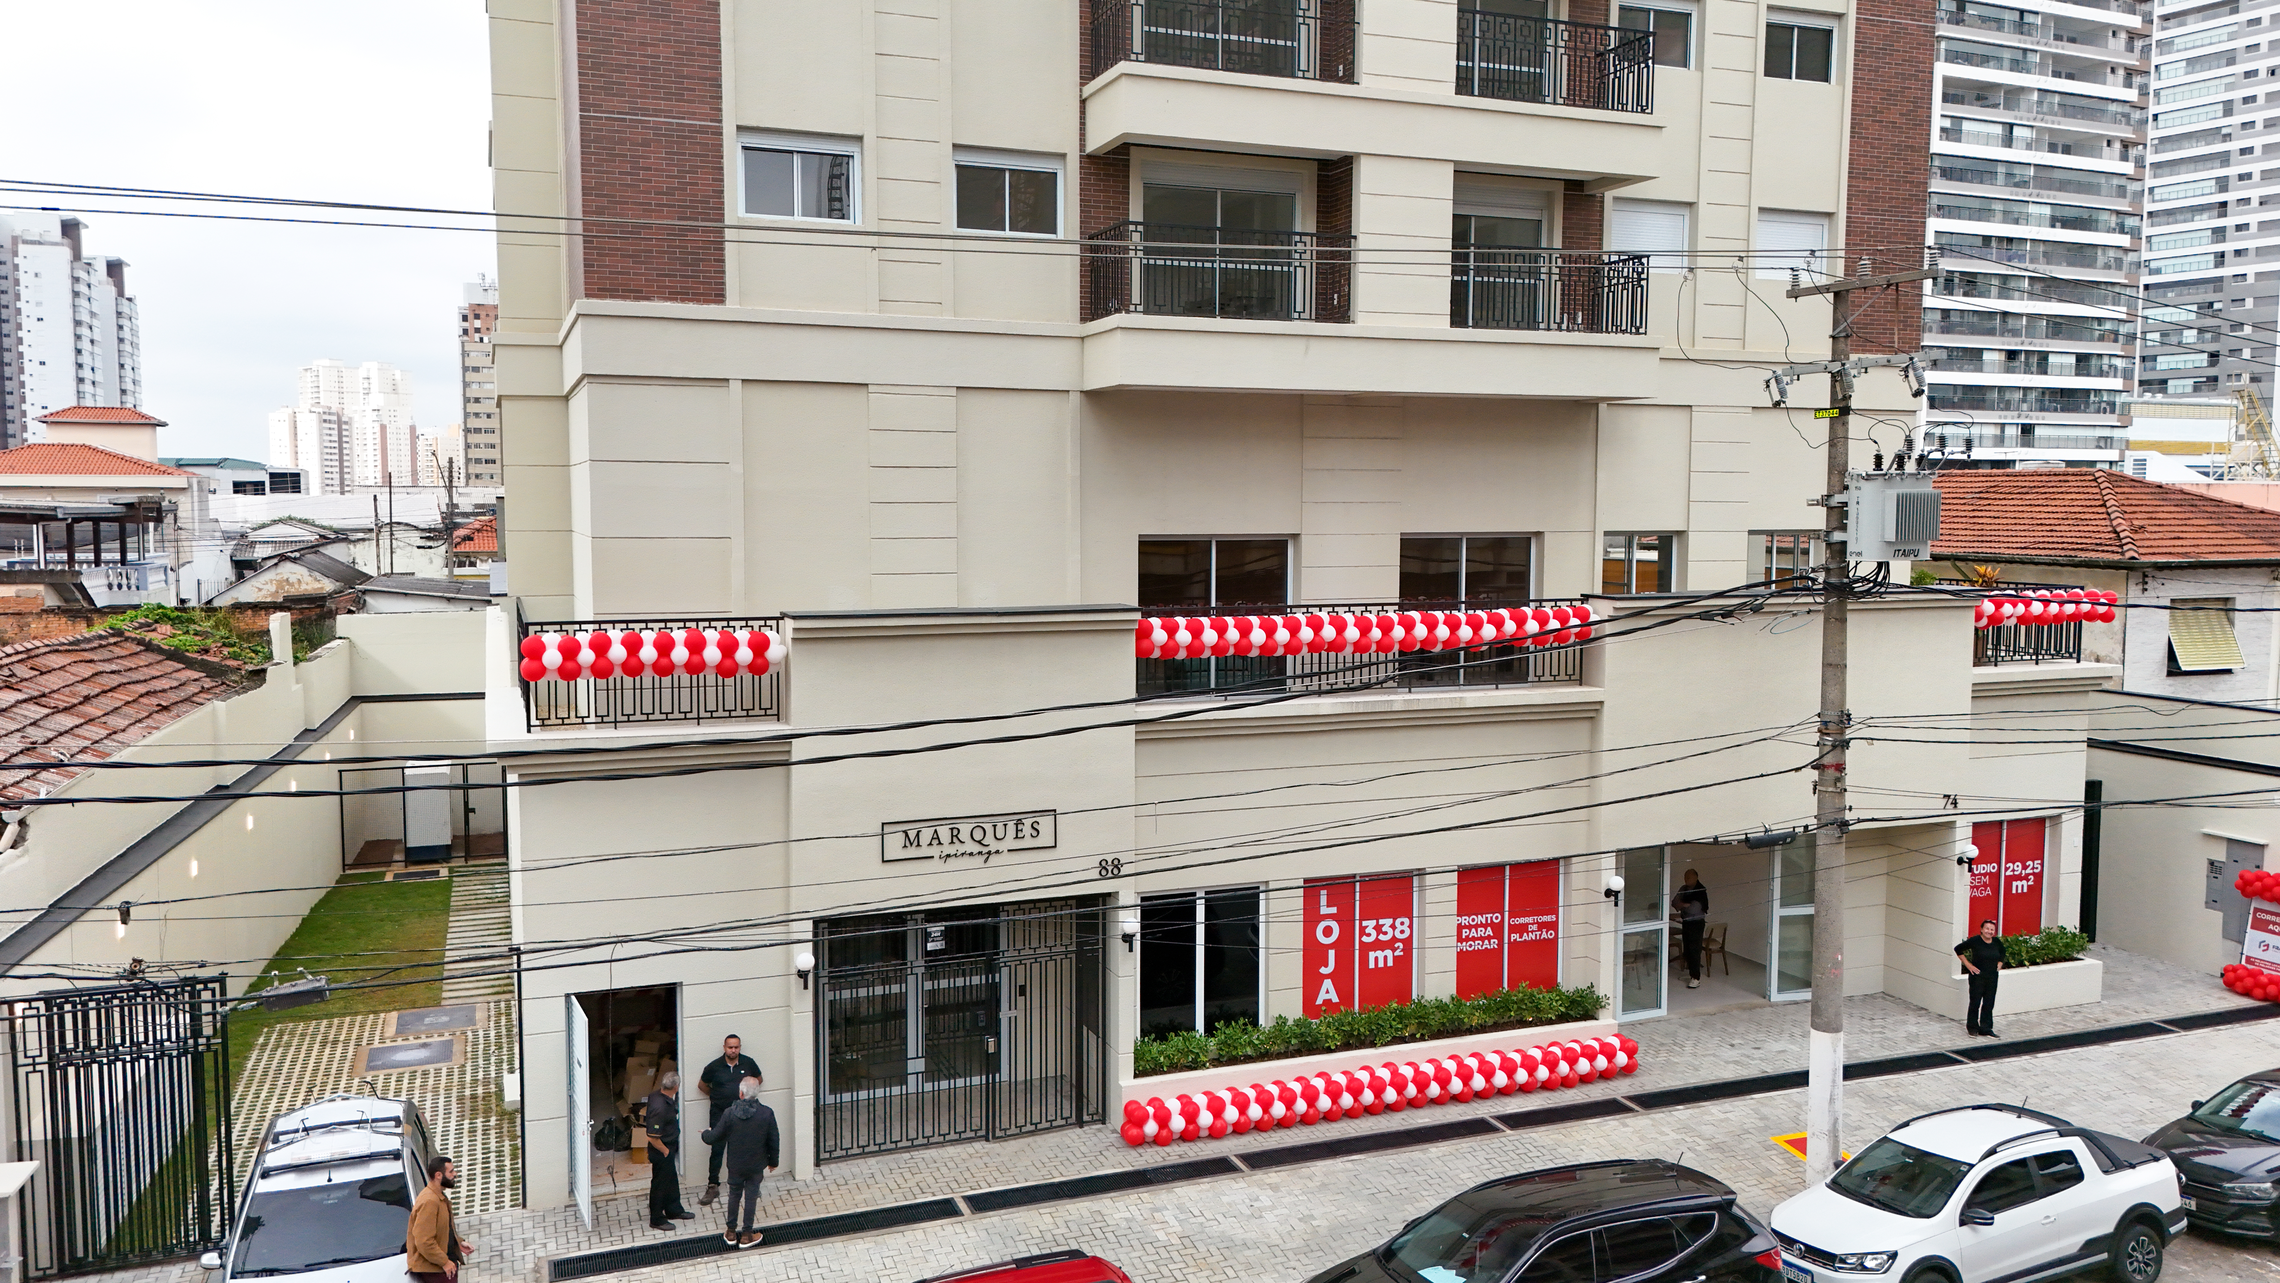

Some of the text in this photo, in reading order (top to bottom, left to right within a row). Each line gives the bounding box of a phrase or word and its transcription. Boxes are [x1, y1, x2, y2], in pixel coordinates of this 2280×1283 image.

[1893, 548, 1919, 558] ITAIPU
[1943, 794, 1958, 809] 74
[902, 819, 1041, 849] MARQUÊS
[938, 849, 1005, 864] ipiranga
[1098, 858, 1122, 877] 88
[2005, 860, 2042, 877] 29,25
[1969, 875, 1989, 887] SEM
[1457, 913, 1501, 926] PRONTO
[1510, 915, 1556, 925] CORRETORES
[1361, 917, 1411, 943] 338
[1462, 927, 1493, 938] PARA
[1511, 929, 1555, 942] PLANTÃO
[1315, 889, 1340, 1005] LOJA
[1457, 939, 1498, 952] MORAR
